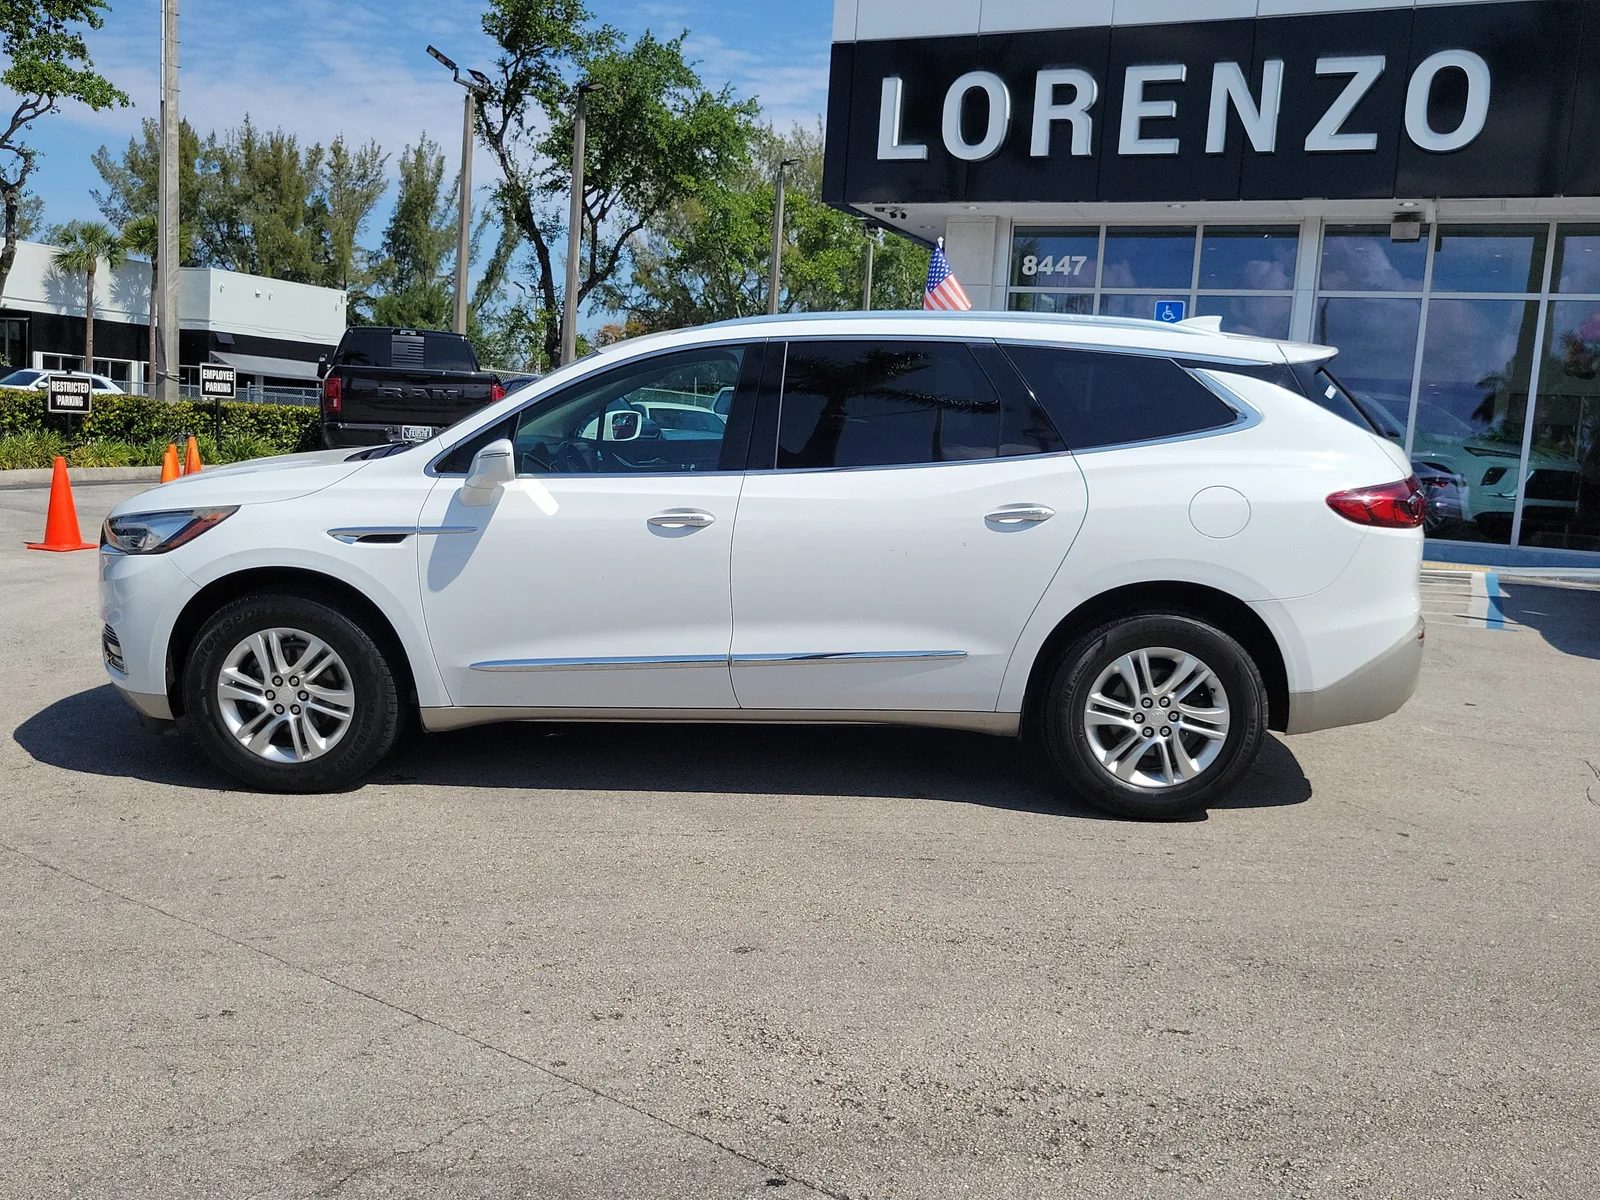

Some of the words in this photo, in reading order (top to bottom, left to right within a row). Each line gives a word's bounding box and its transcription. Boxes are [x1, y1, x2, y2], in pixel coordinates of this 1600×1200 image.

[876, 49, 1492, 162] LORENZO
[1022, 255, 1087, 276] 8447
[202, 369, 234, 382] EMPLOYEE
[51, 380, 90, 394] RESTRICTED
[205, 381, 232, 393] PARKING
[377, 386, 458, 401] RAM
[56, 394, 84, 407] PARKING
